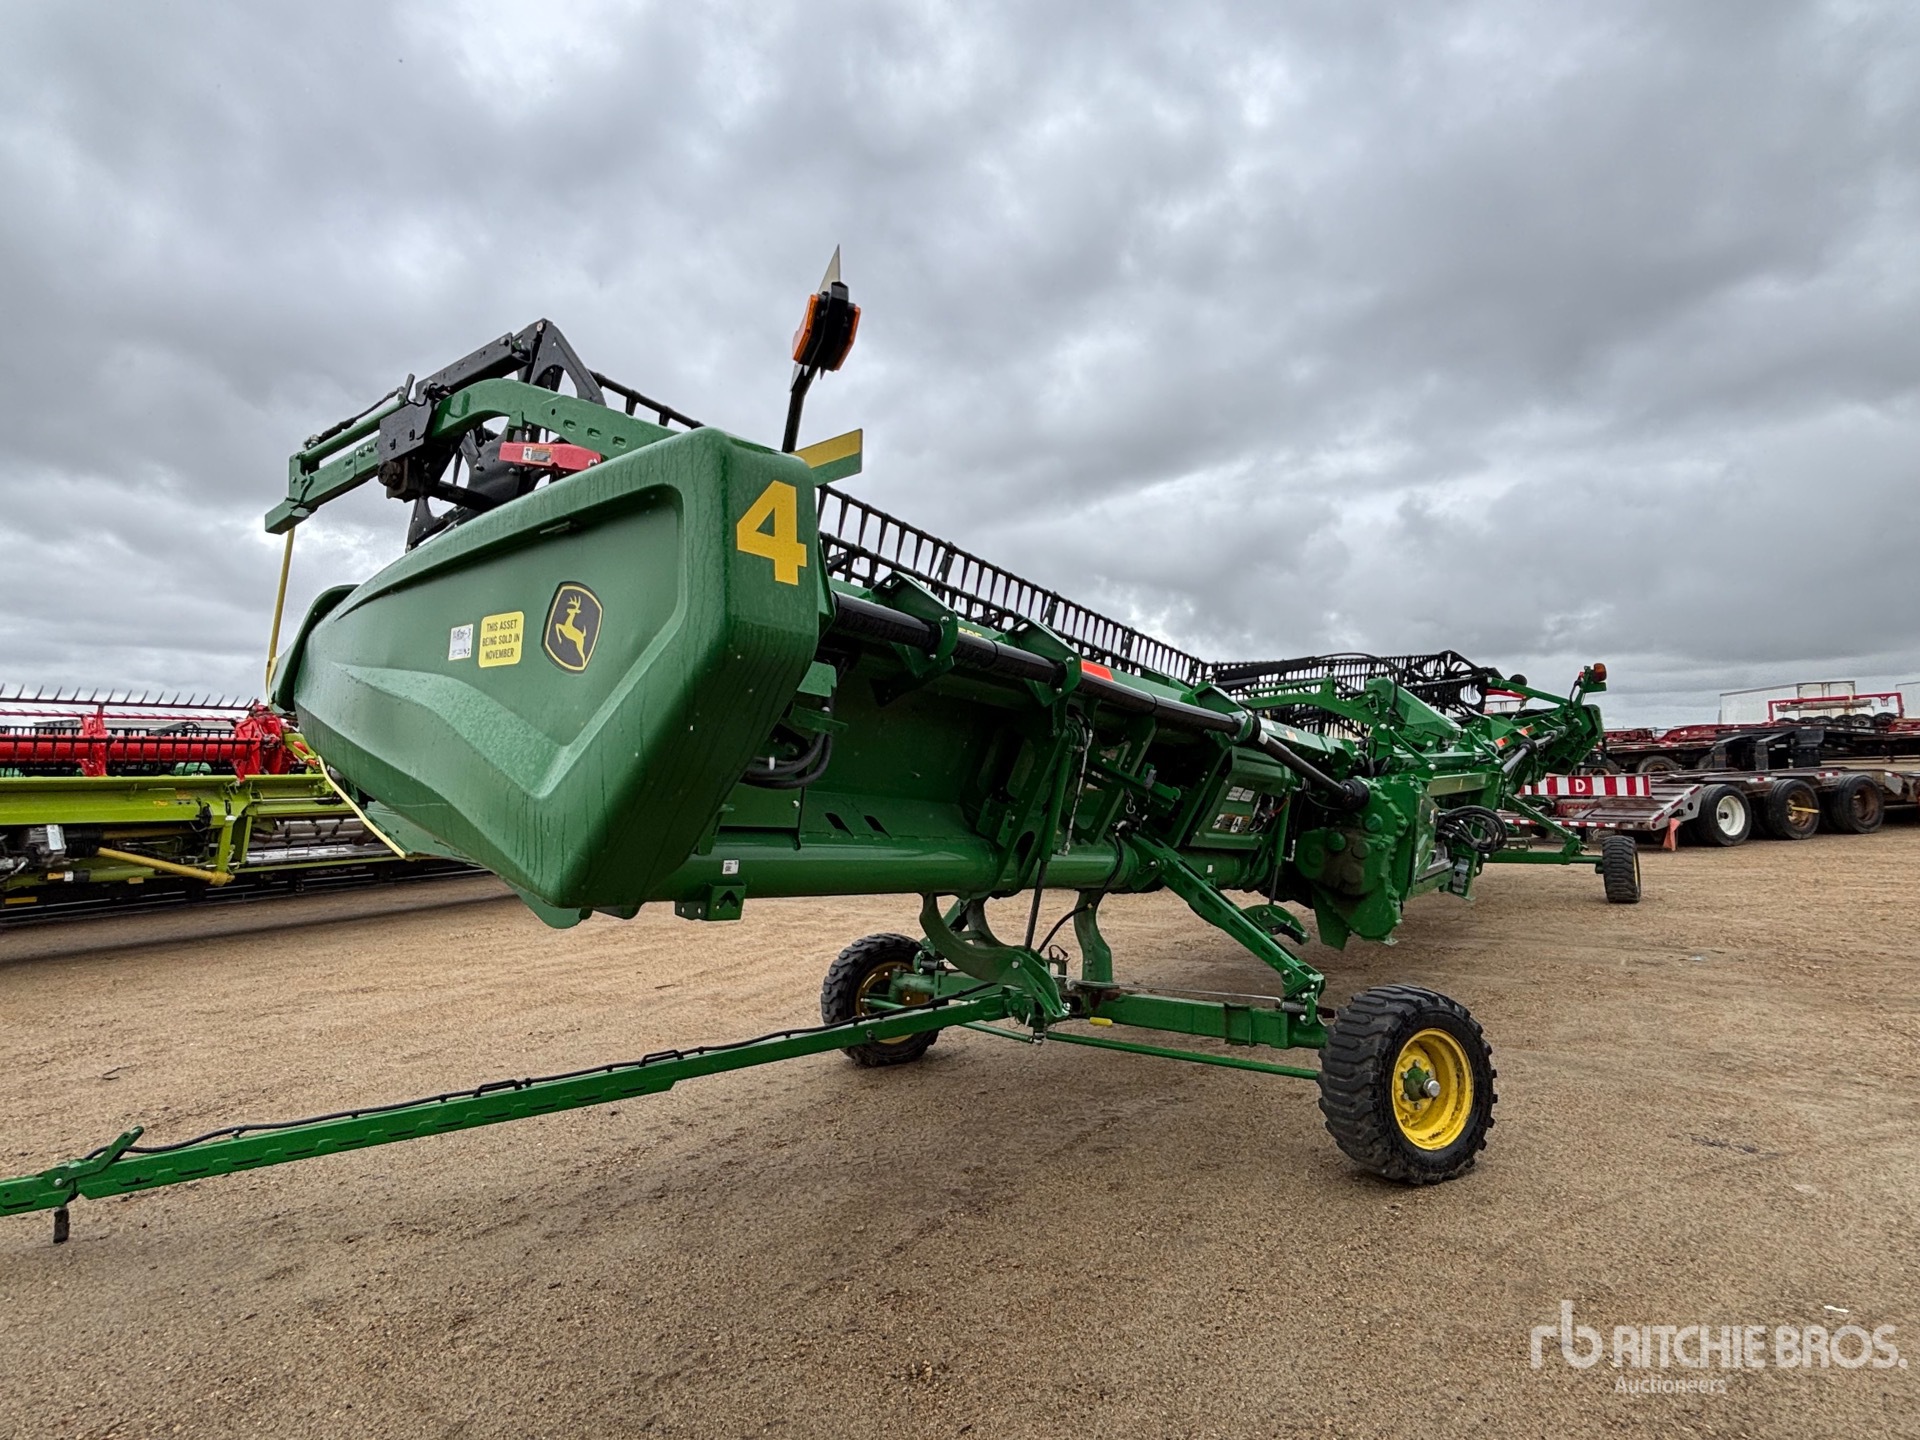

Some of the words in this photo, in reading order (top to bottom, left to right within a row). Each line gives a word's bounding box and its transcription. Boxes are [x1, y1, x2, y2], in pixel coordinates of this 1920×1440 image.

[736, 479, 808, 586] 4
[486, 622, 499, 632] THIS
[500, 619, 518, 630] ASSET
[482, 636, 497, 647] BEING
[498, 634, 512, 645] SOLD
[514, 633, 520, 643] IN
[485, 647, 515, 660] NOVEMBER
[1575, 779, 1586, 792] D
